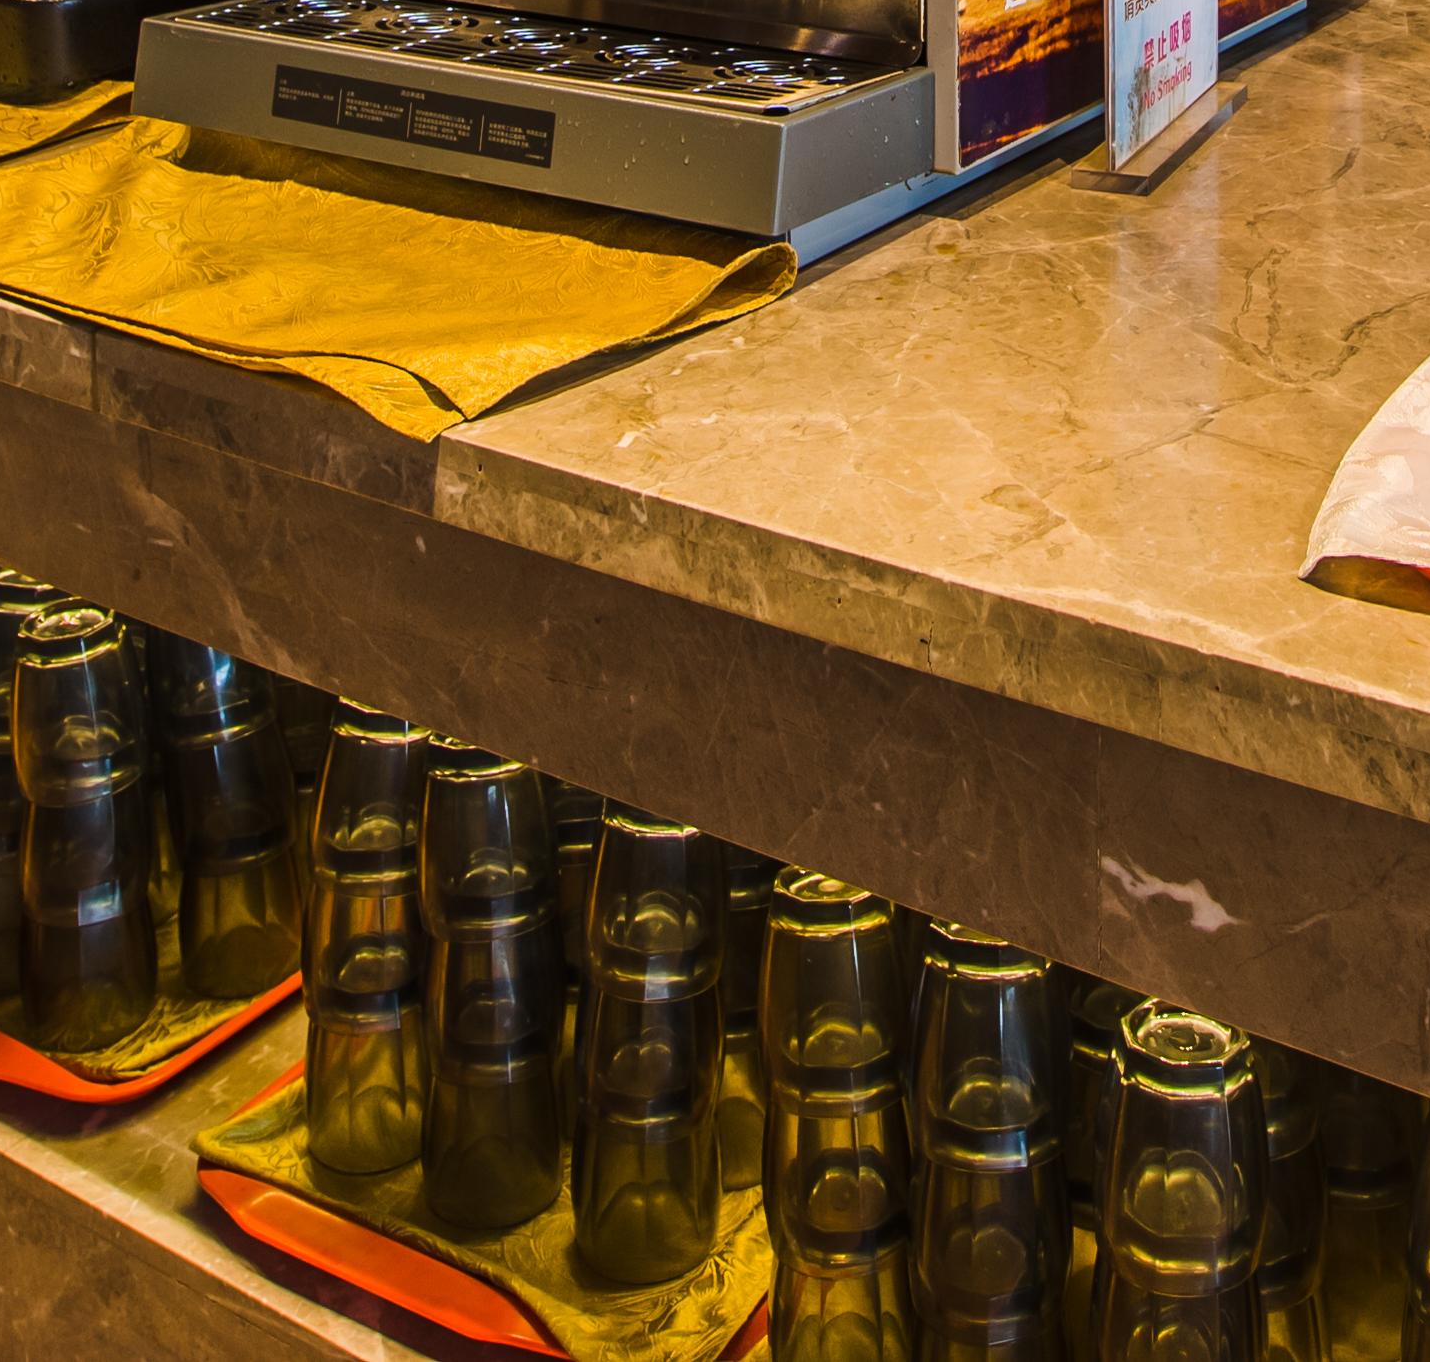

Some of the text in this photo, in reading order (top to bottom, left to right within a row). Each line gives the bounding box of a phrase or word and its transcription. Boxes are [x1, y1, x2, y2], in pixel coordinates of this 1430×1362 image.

[1143, 11, 1192, 71] 禁止吸烟
[1143, 60, 1193, 111] No Smoking
